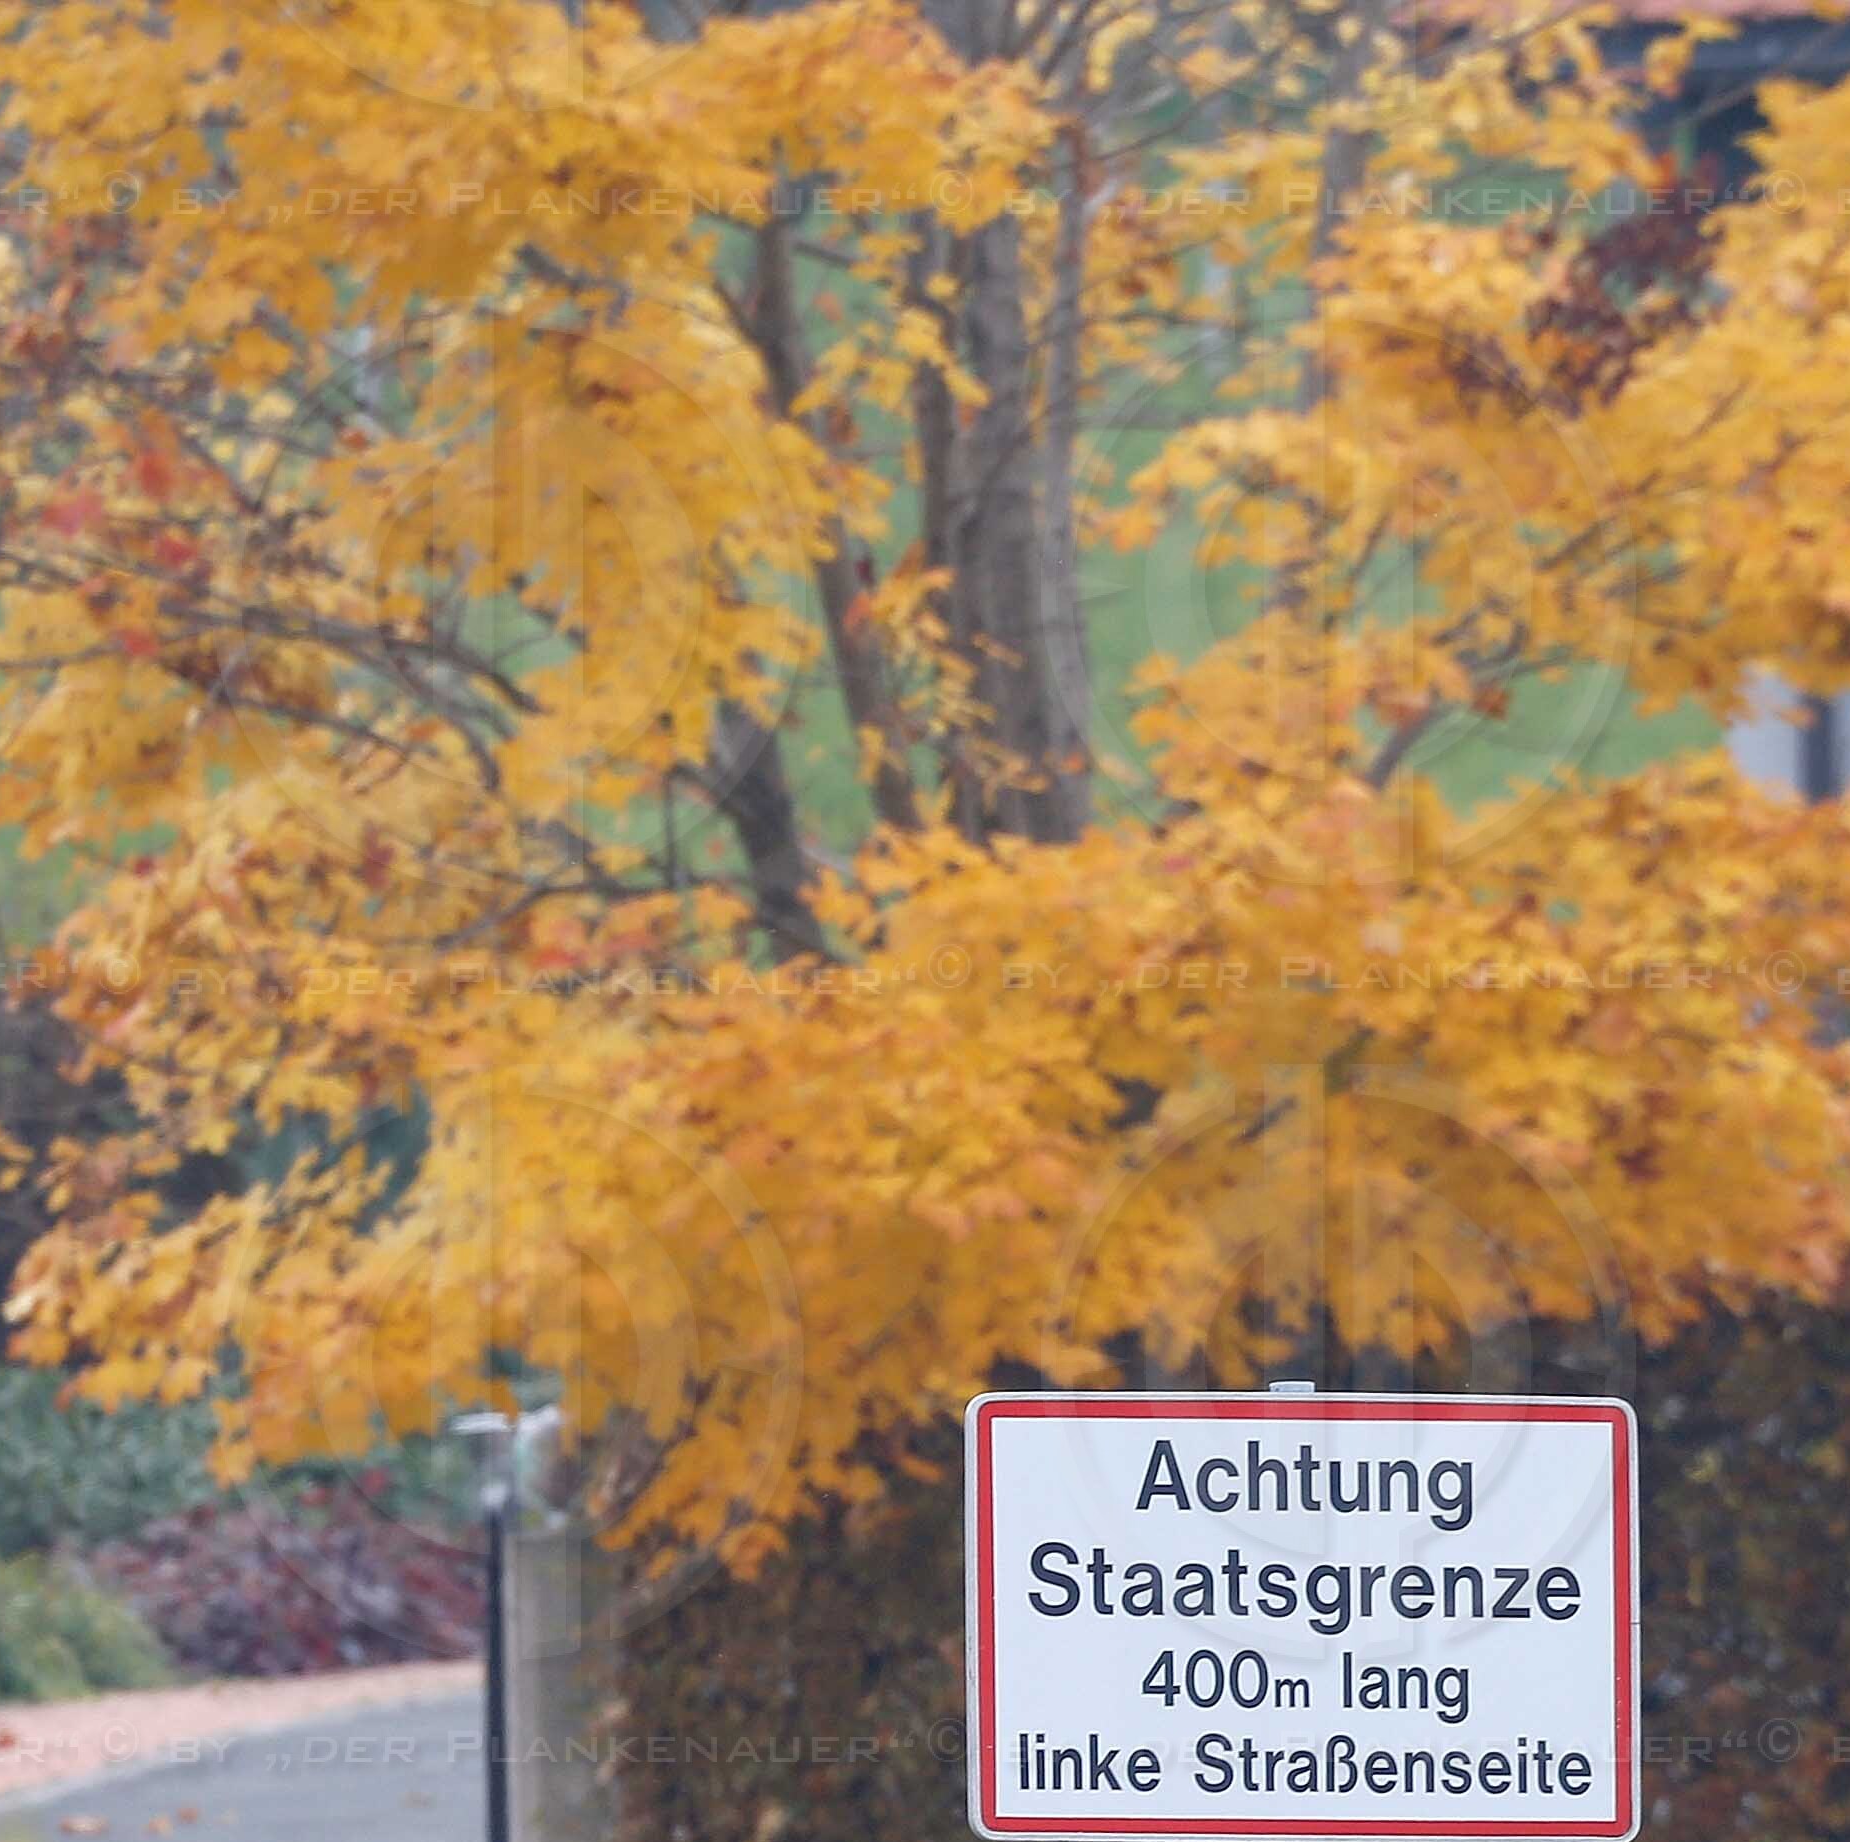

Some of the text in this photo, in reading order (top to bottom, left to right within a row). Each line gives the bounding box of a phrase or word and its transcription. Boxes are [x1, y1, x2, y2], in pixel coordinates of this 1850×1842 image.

[1135, 1439, 1473, 1532] Achtung
[1028, 1541, 1581, 1636] Staatsgrenze
[1343, 1651, 1469, 1724] lang
[1019, 1733, 1161, 1792] linke
[1194, 1733, 1592, 1796] Straßenseite
